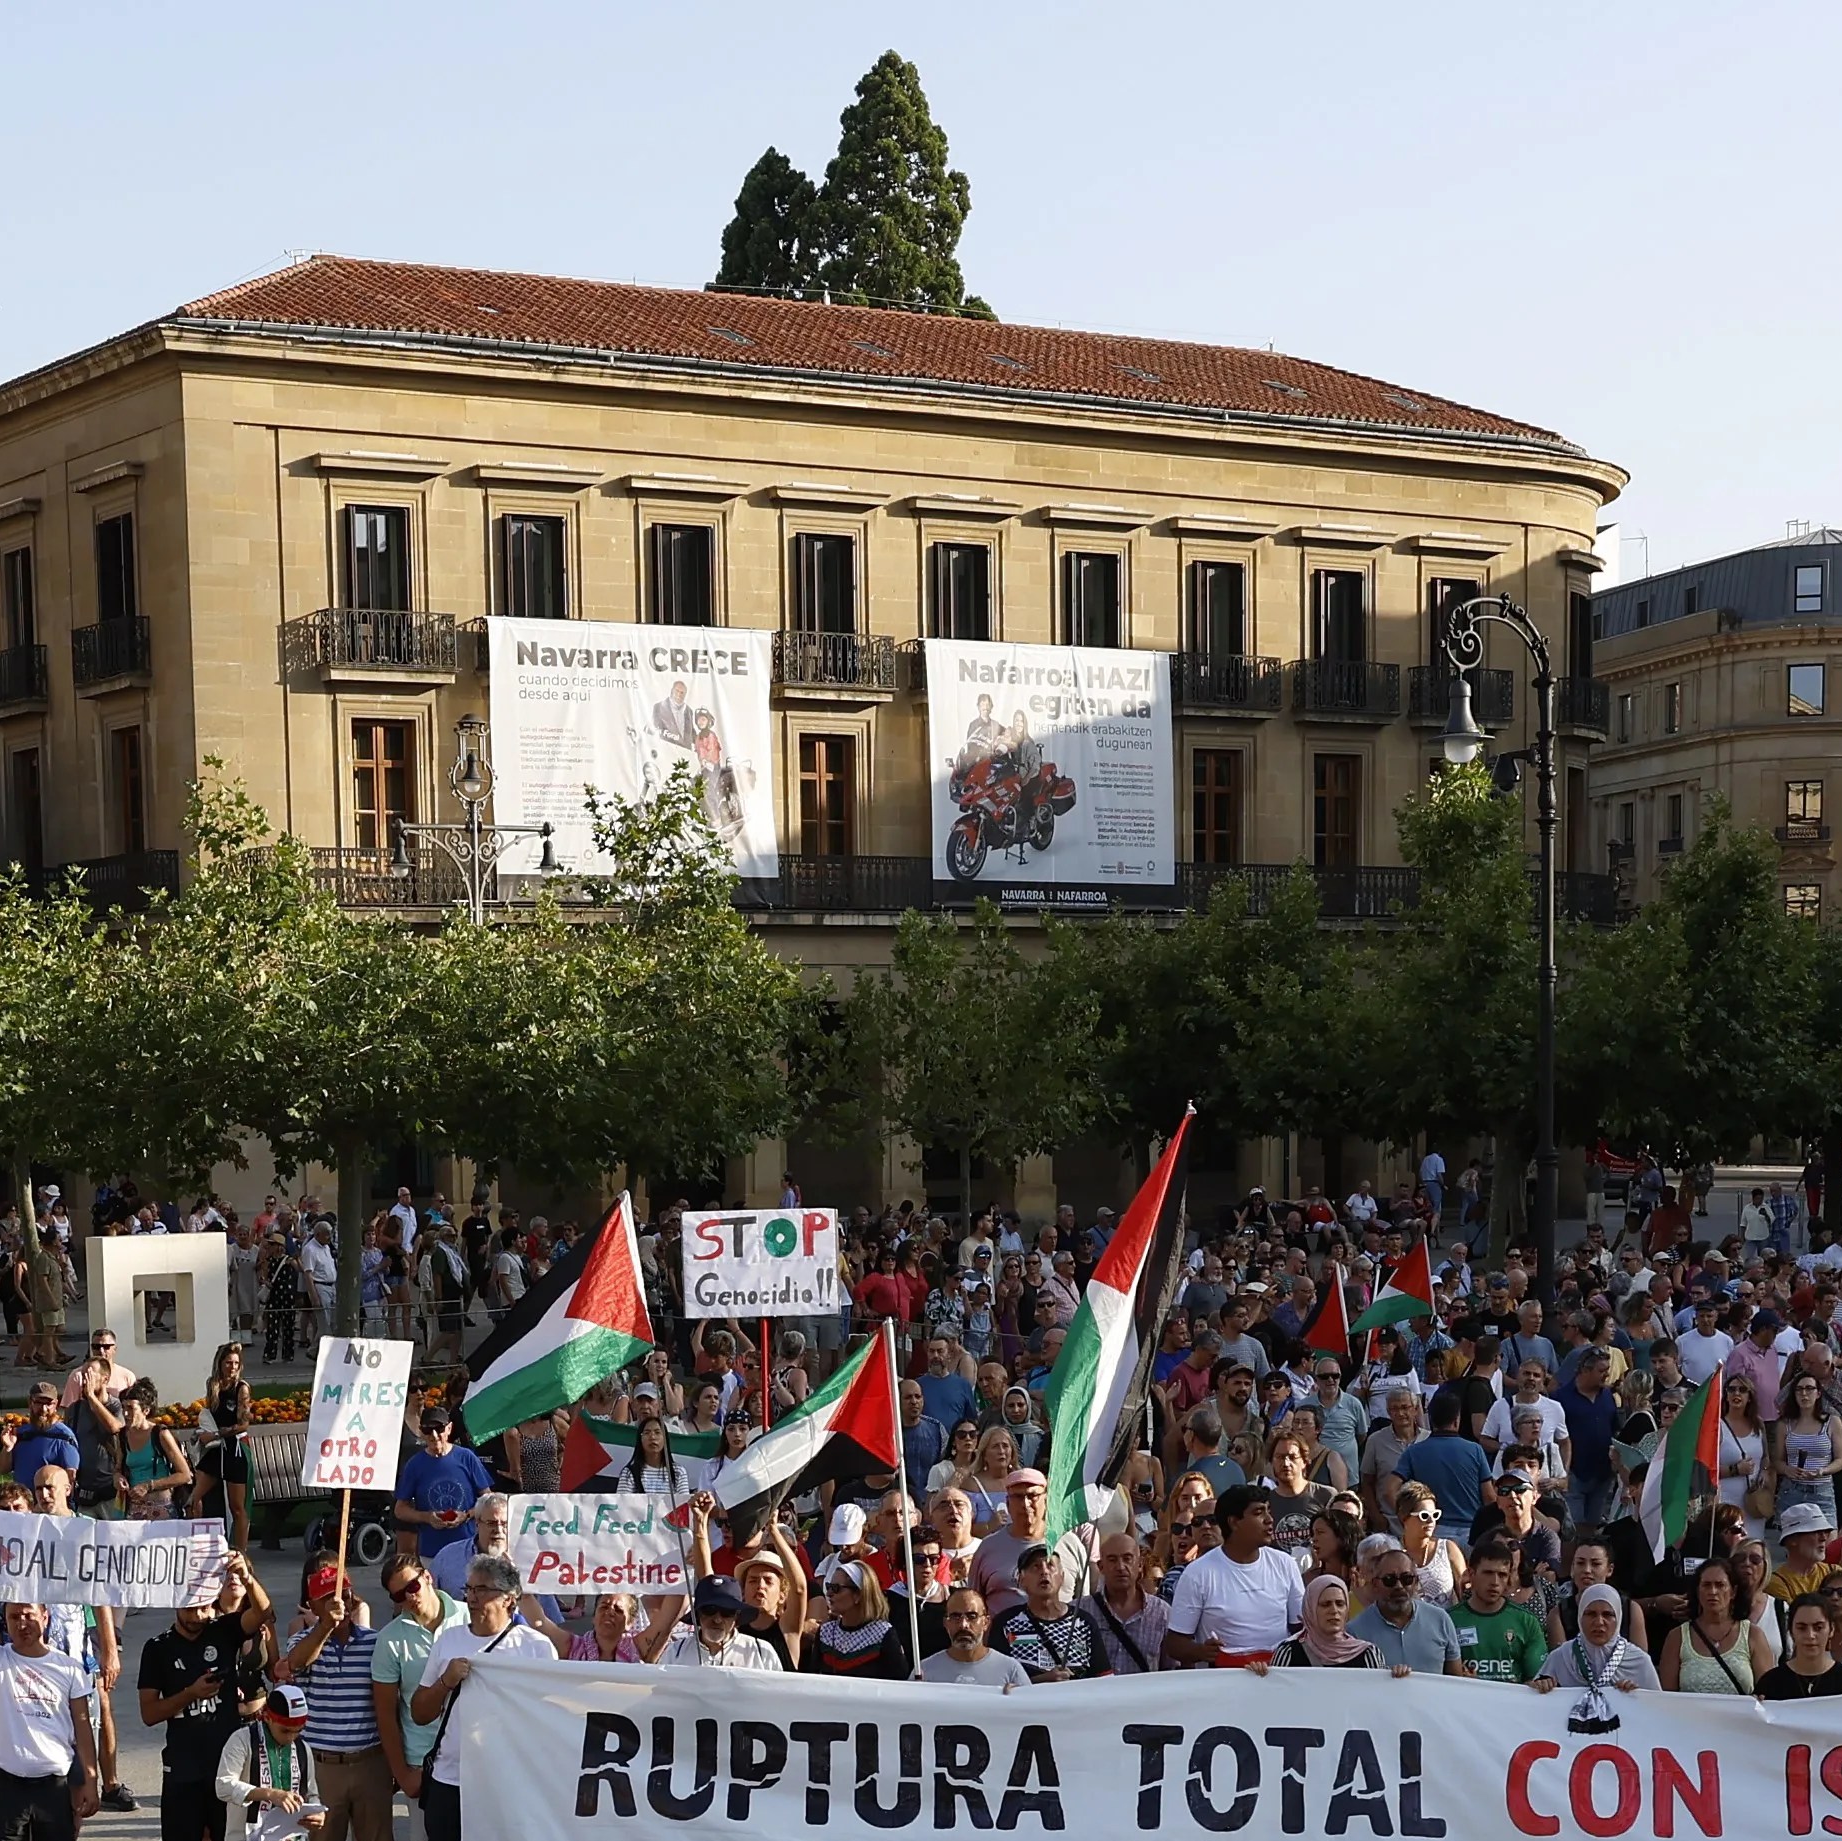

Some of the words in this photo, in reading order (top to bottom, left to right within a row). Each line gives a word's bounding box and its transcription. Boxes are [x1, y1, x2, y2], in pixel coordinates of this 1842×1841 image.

[516, 640, 639, 670] Navarra
[649, 647, 749, 676] CRECE
[518, 674, 568, 687] cuando
[572, 675, 639, 690] decidimos
[958, 659, 1078, 688] Nafarroa
[1087, 666, 1151, 692] HAZI
[518, 688, 559, 701] desde
[562, 690, 591, 702] aquí
[1029, 690, 1113, 720] egiten
[1121, 694, 1152, 719] da
[1033, 721, 1089, 735] hemendik
[1092, 722, 1152, 737] erabakitzen
[1096, 737, 1152, 752] dugunean
[1001, 889, 1045, 900] NAVARRA
[1057, 890, 1108, 902] NAFARROA
[693, 1213, 829, 1260] STOP
[344, 1343, 382, 1368] NO
[345, 1411, 366, 1432] A
[320, 1436, 377, 1458] OTRO
[317, 1463, 374, 1485] LADO
[520, 1505, 579, 1535] Feed
[592, 1503, 654, 1535] Feed
[25, 1540, 68, 1581] AL
[78, 1543, 188, 1586] GENOCIDIO
[527, 1549, 681, 1585] Palestine
[575, 1712, 1066, 1831] RUPTURA
[1123, 1724, 1447, 1839] TOTAL
[1506, 1740, 1723, 1840] CON
